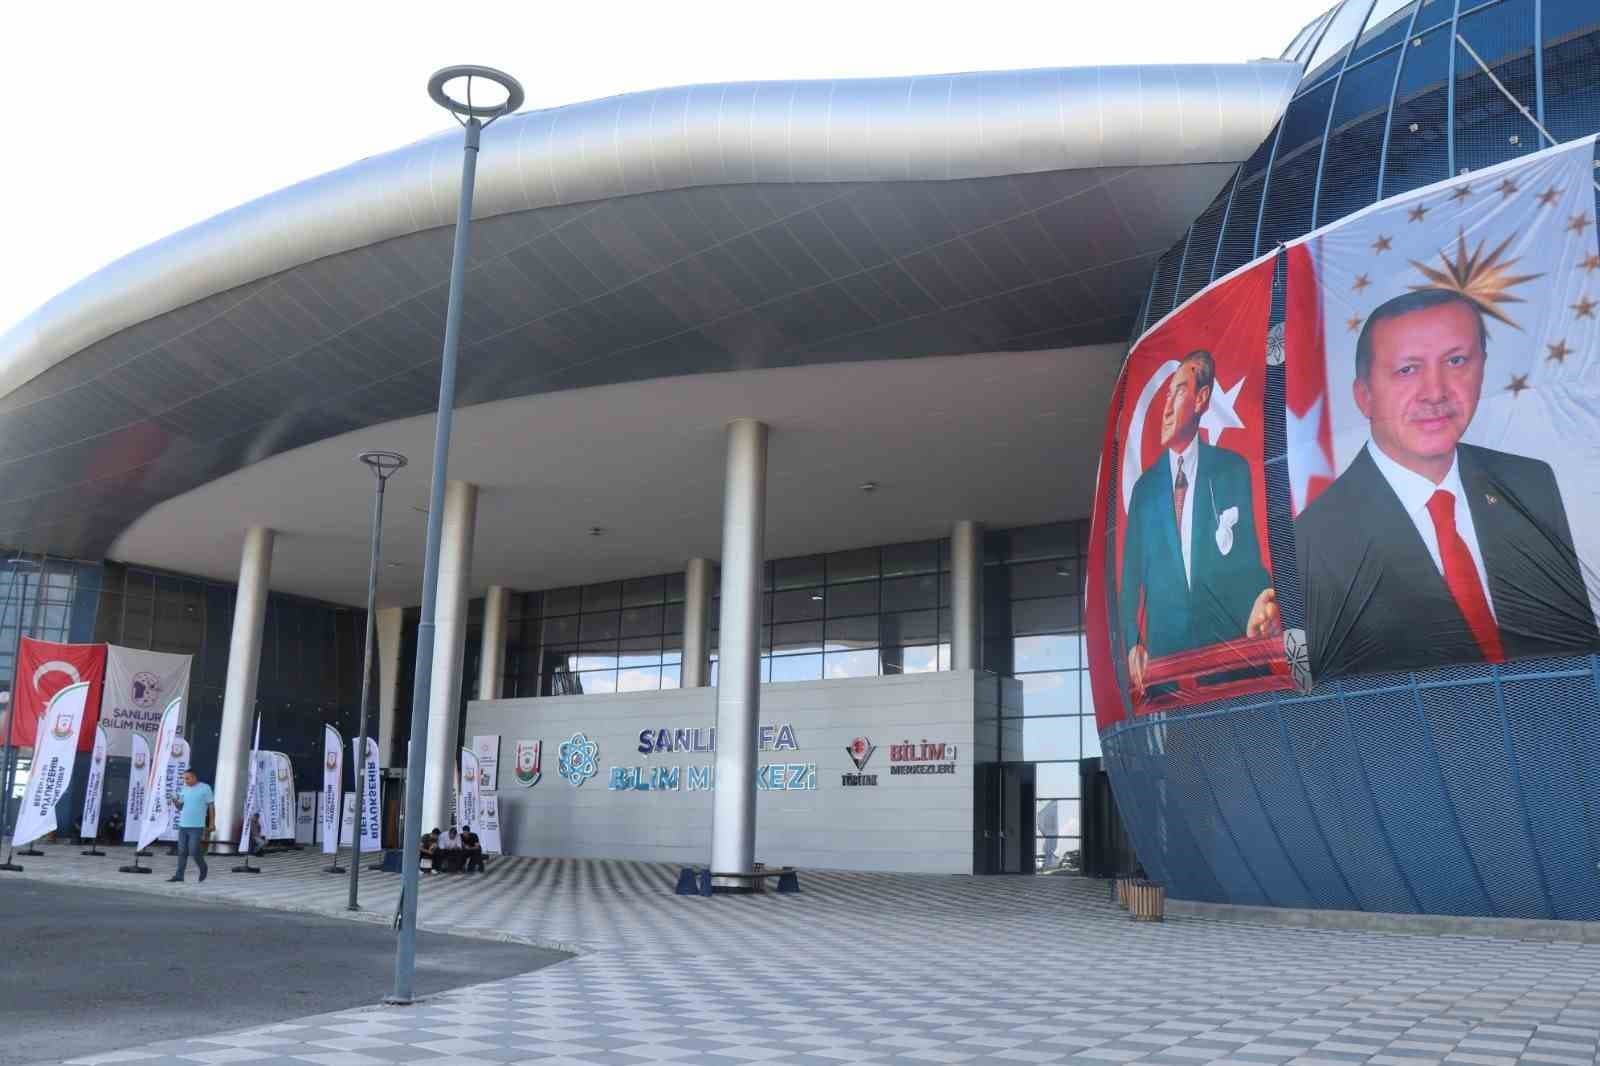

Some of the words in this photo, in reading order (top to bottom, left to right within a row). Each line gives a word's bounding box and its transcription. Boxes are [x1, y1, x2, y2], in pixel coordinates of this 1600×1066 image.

[638, 722, 800, 757] ŞANLIFA
[889, 739, 946, 761] BİLİM
[687, 760, 817, 792] MKEZİ
